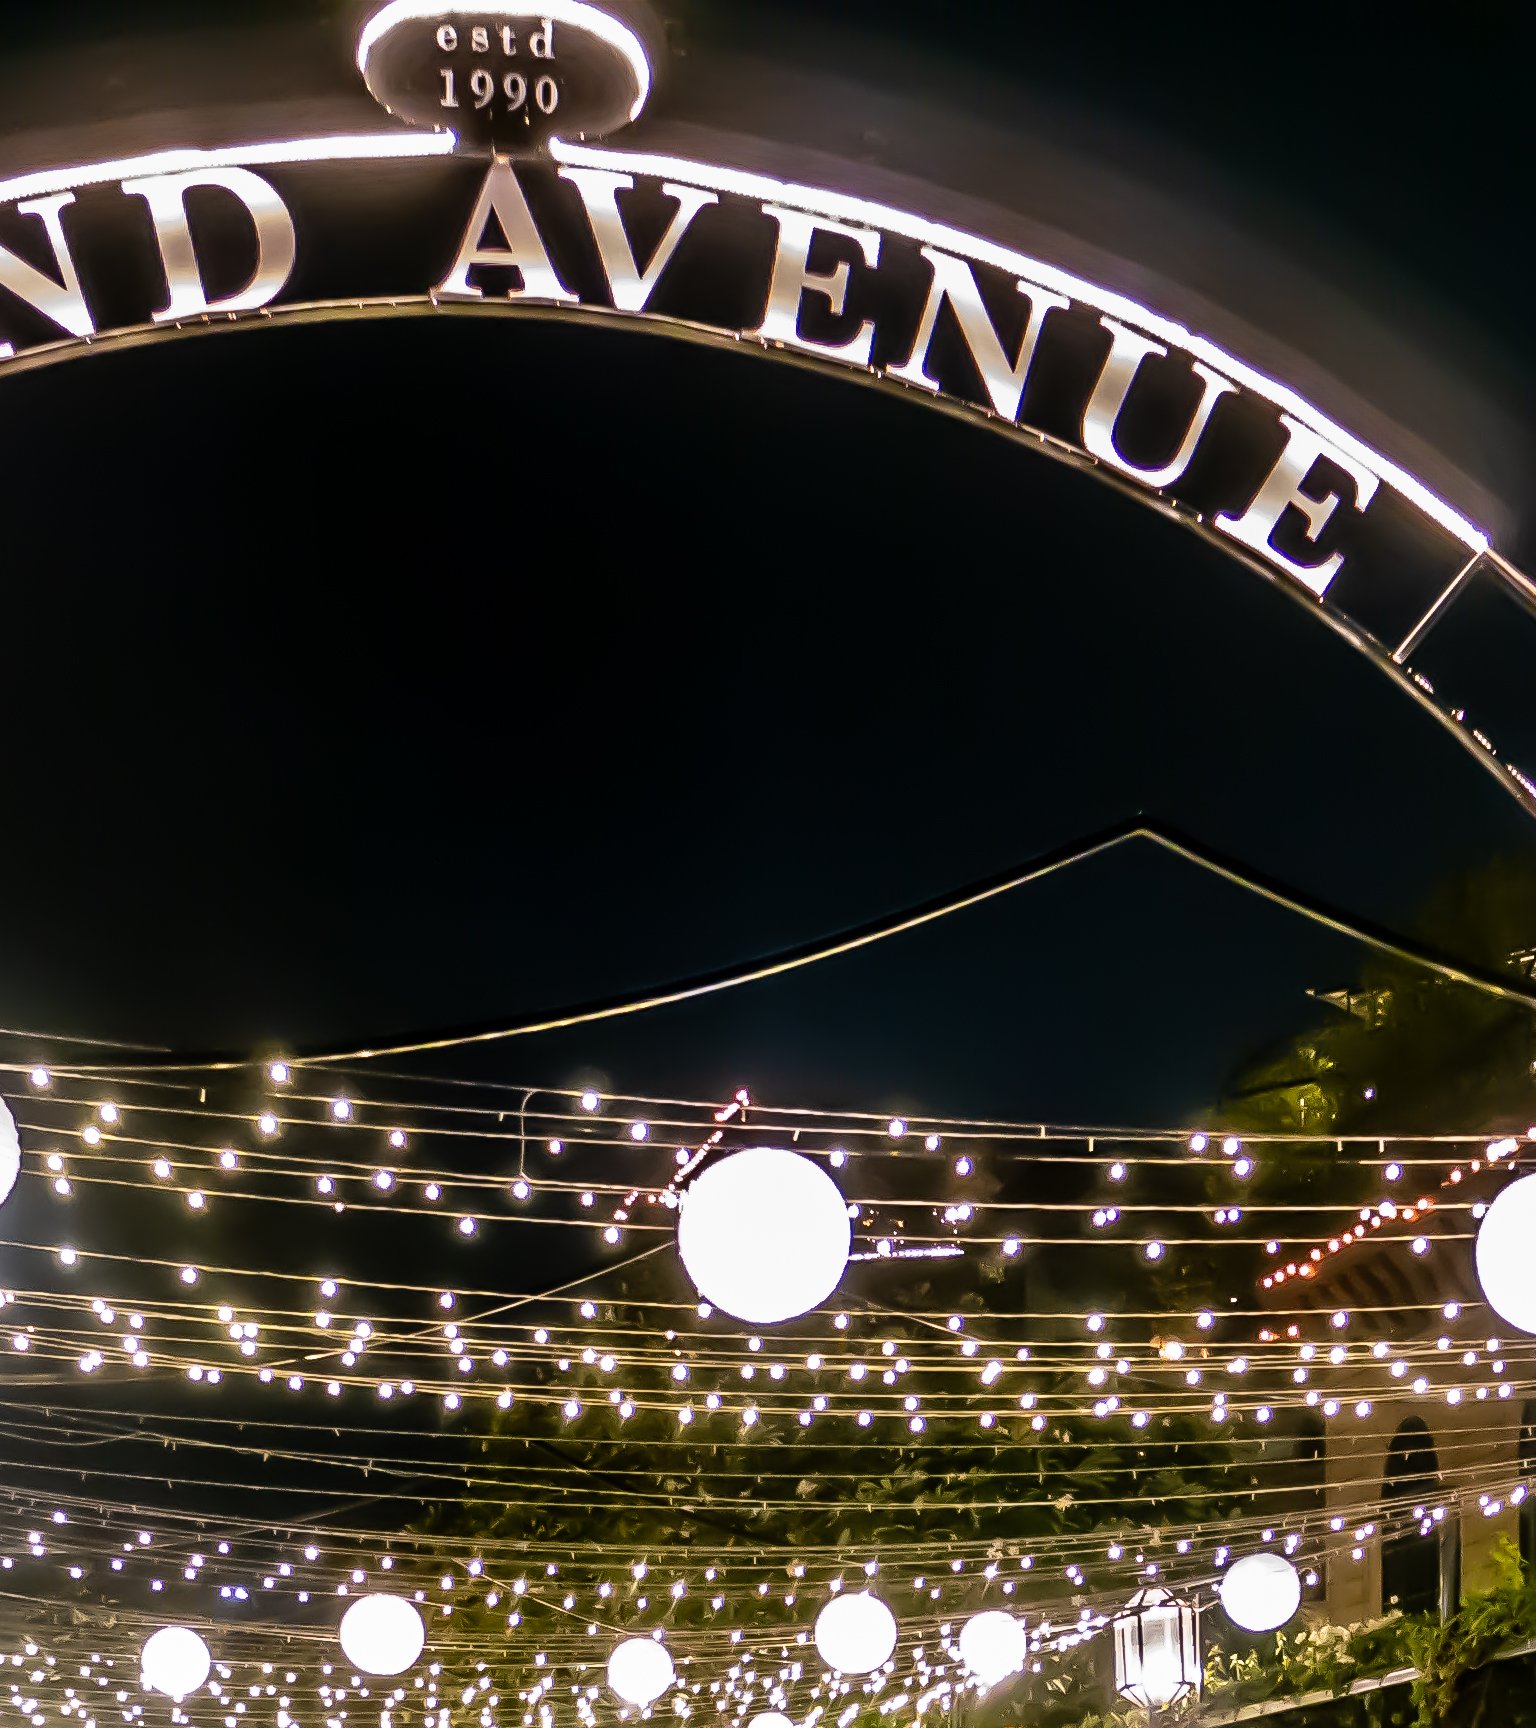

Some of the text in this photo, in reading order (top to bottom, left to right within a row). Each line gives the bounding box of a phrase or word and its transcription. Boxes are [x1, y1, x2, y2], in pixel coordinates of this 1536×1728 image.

[436, 19, 556, 60] estd
[439, 68, 559, 114] 1990
[431, 155, 1380, 598] AVENUE
